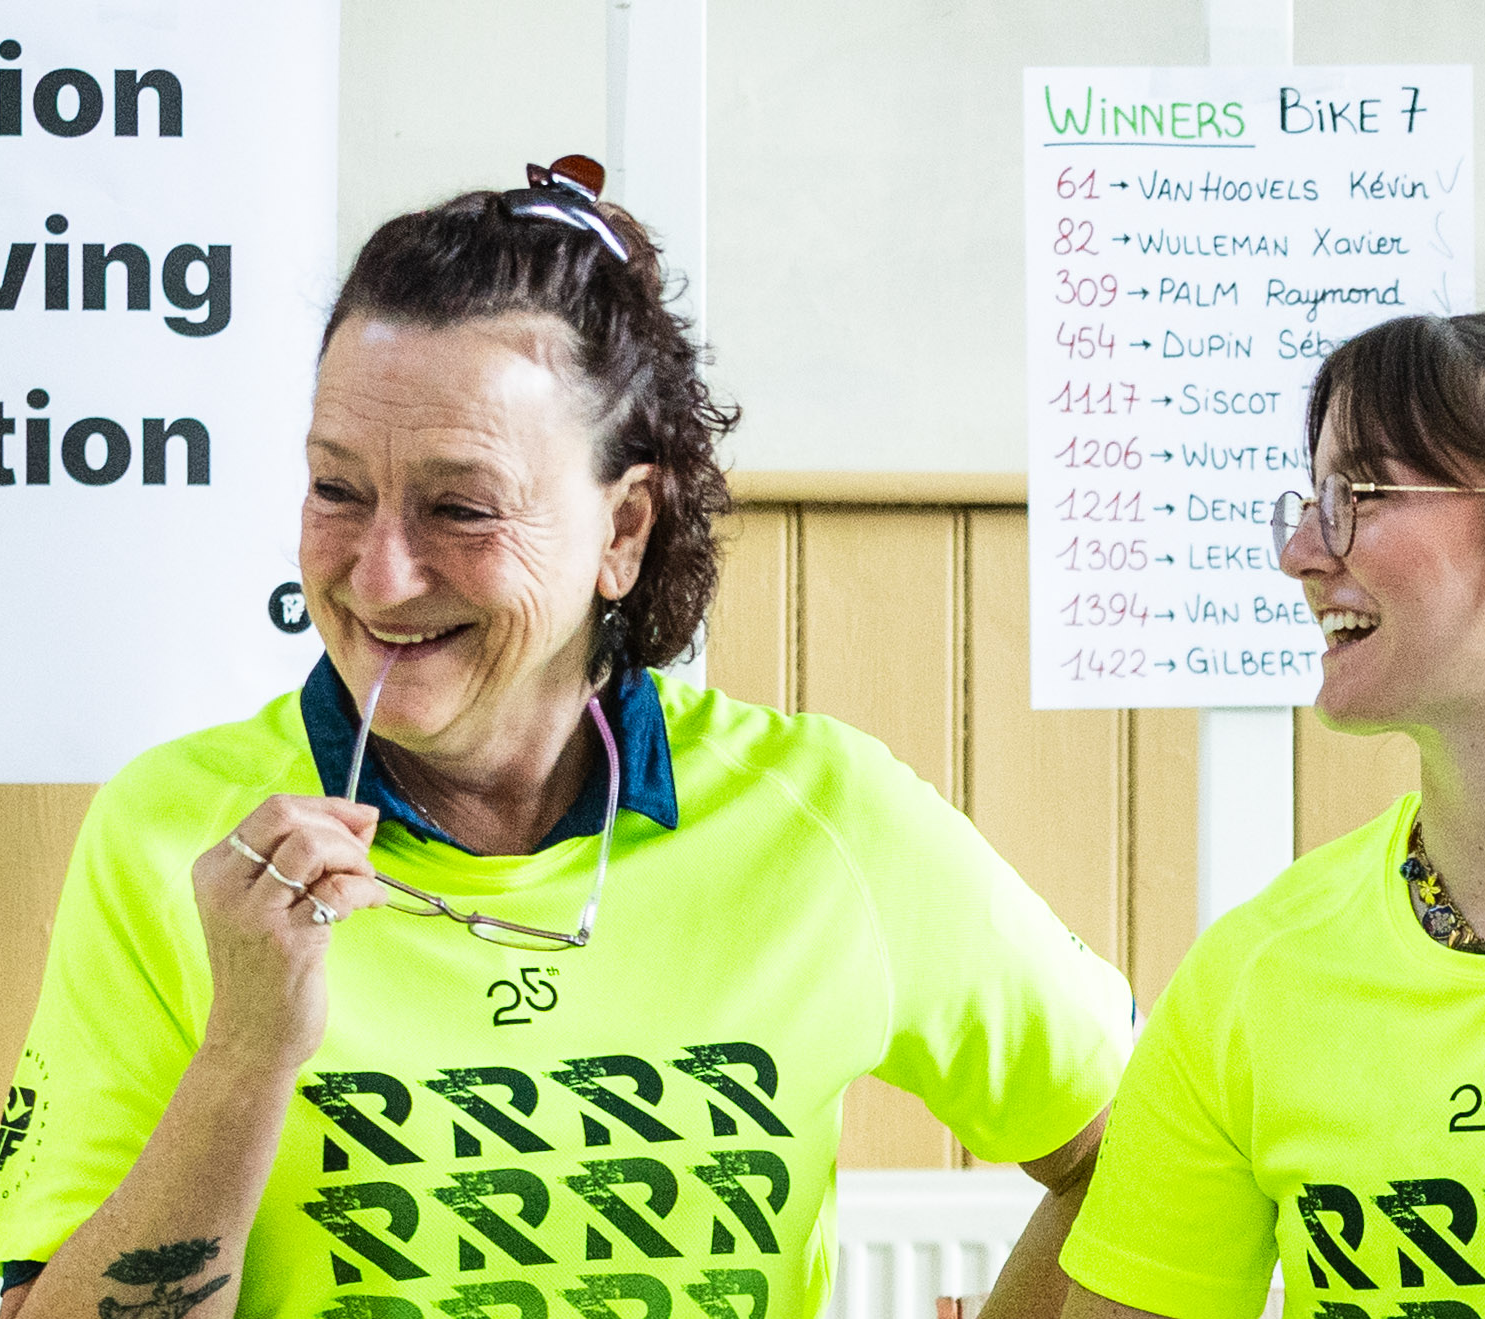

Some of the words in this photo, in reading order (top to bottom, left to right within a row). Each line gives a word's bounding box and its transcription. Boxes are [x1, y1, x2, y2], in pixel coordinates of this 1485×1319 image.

[1400, 85, 1428, 134] 7
[1056, 166, 1100, 200] 61
[1349, 170, 1430, 200] Kévin
[1053, 216, 1099, 256] 82
[1137, 228, 1289, 258] WULLEMAN
[1312, 227, 1410, 257] Xavier
[1055, 268, 1118, 308] 309
[1158, 276, 1239, 307] PALM
[1265, 277, 1407, 323] Raymond
[1056, 321, 1116, 360] 454
[1049, 380, 1140, 415] 1117
[1054, 435, 1143, 471] 1206
[1055, 488, 1145, 523] 1211
[1187, 493, 1277, 523] DENE
[1056, 535, 1148, 572] 1305
[1060, 592, 1150, 627] 1394
[1185, 593, 1240, 625] VAN
[1061, 648, 1147, 681] 1422
